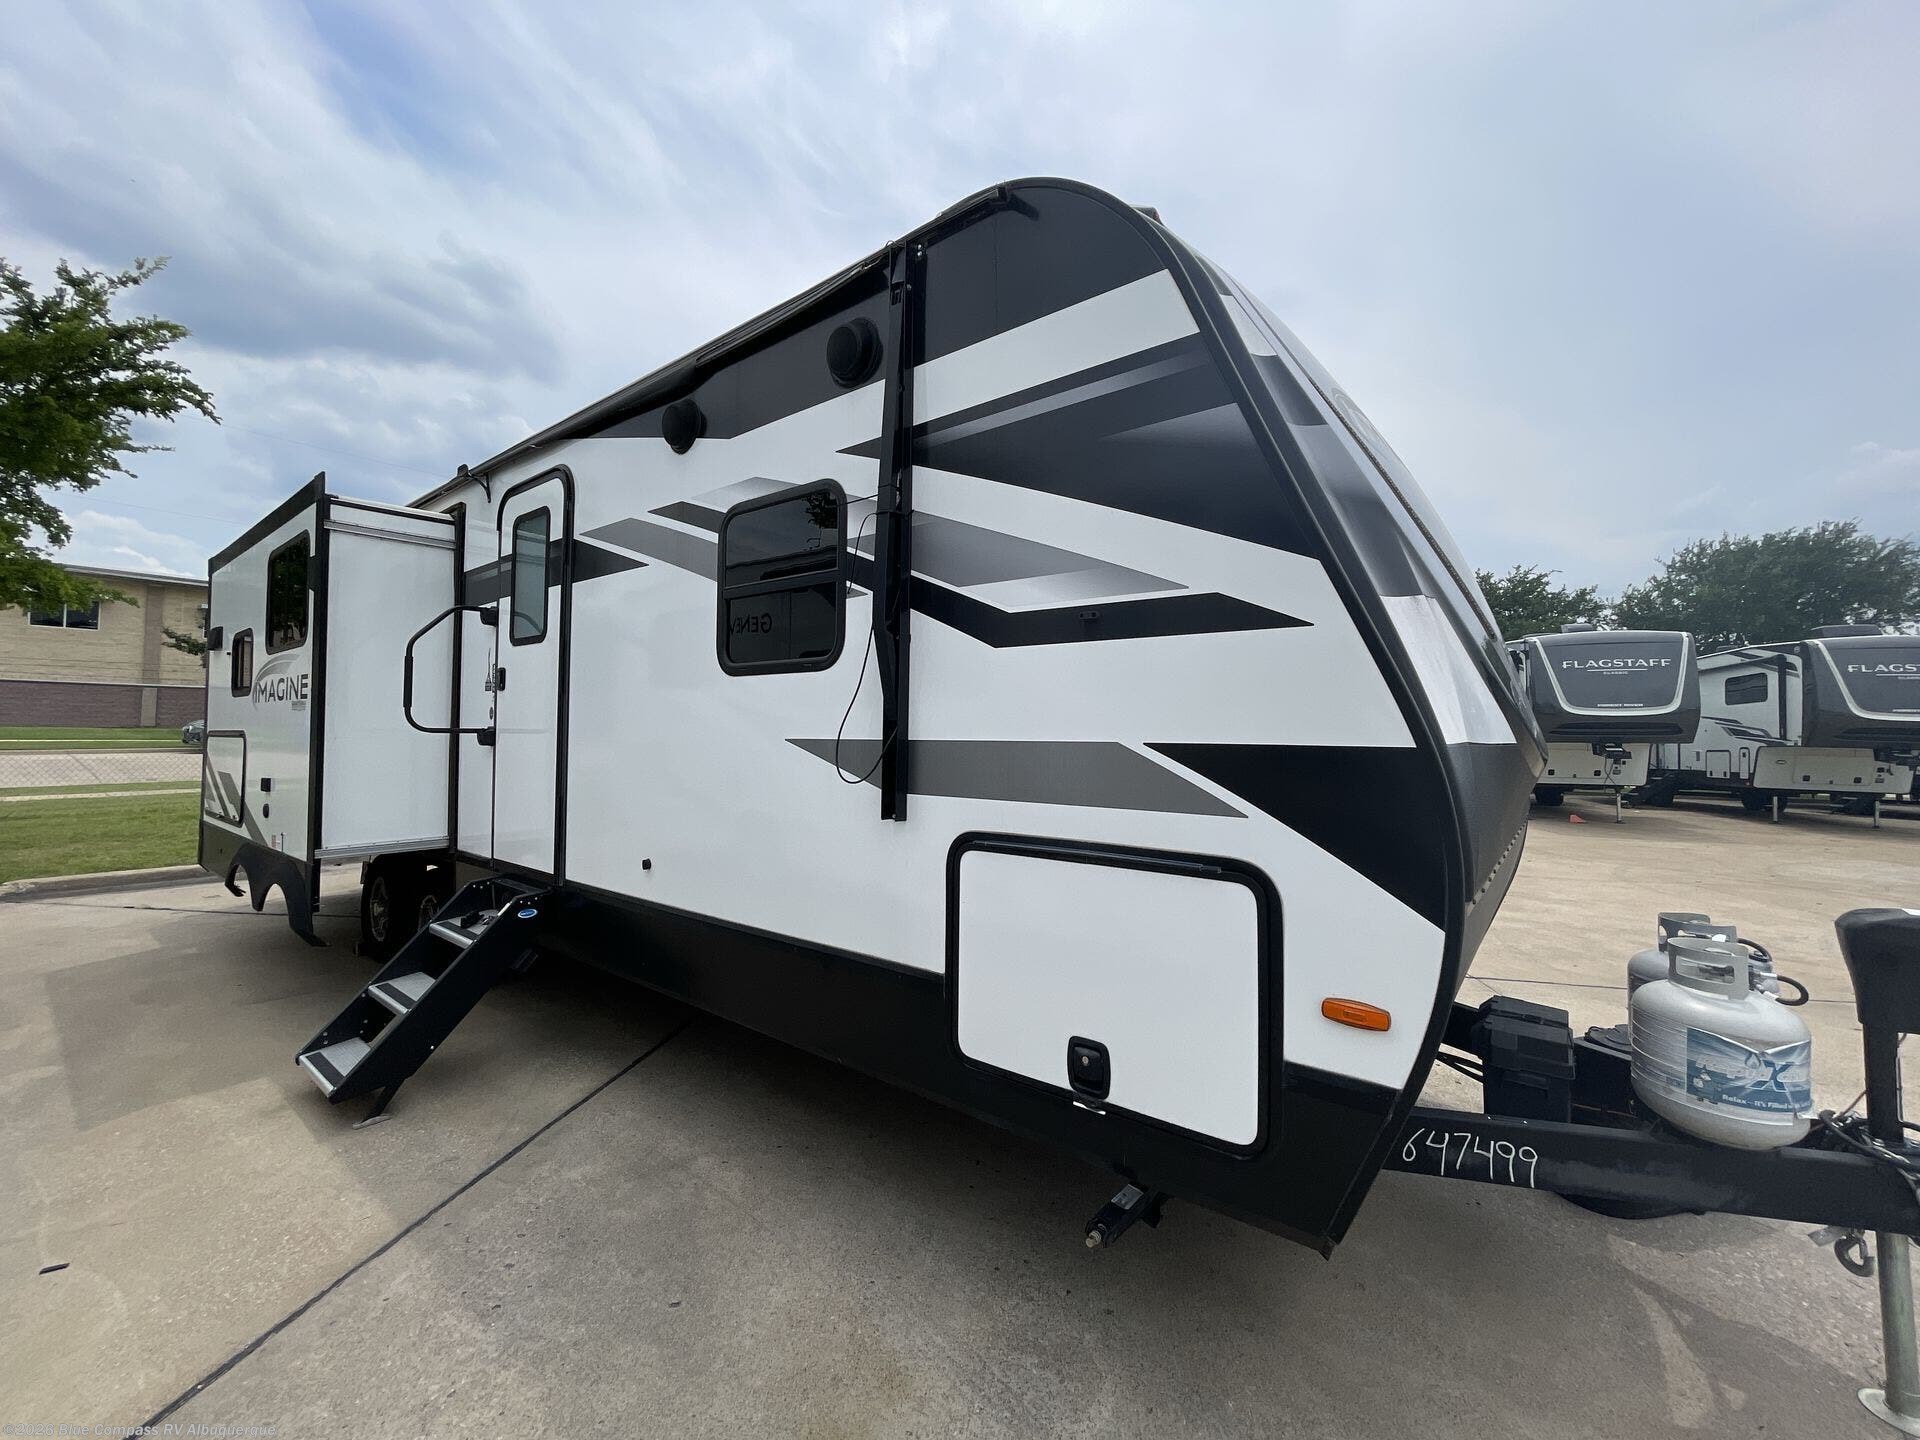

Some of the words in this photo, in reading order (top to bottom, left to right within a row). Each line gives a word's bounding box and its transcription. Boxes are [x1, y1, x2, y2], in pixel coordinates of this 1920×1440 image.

[1562, 658, 1672, 669] FLAGSTAFF
[1847, 663, 1920, 673] FLAGS
[252, 674, 309, 704] IMAGINE
[1722, 1094, 1747, 1105] Relax
[1402, 1128, 1538, 1188] 647499
